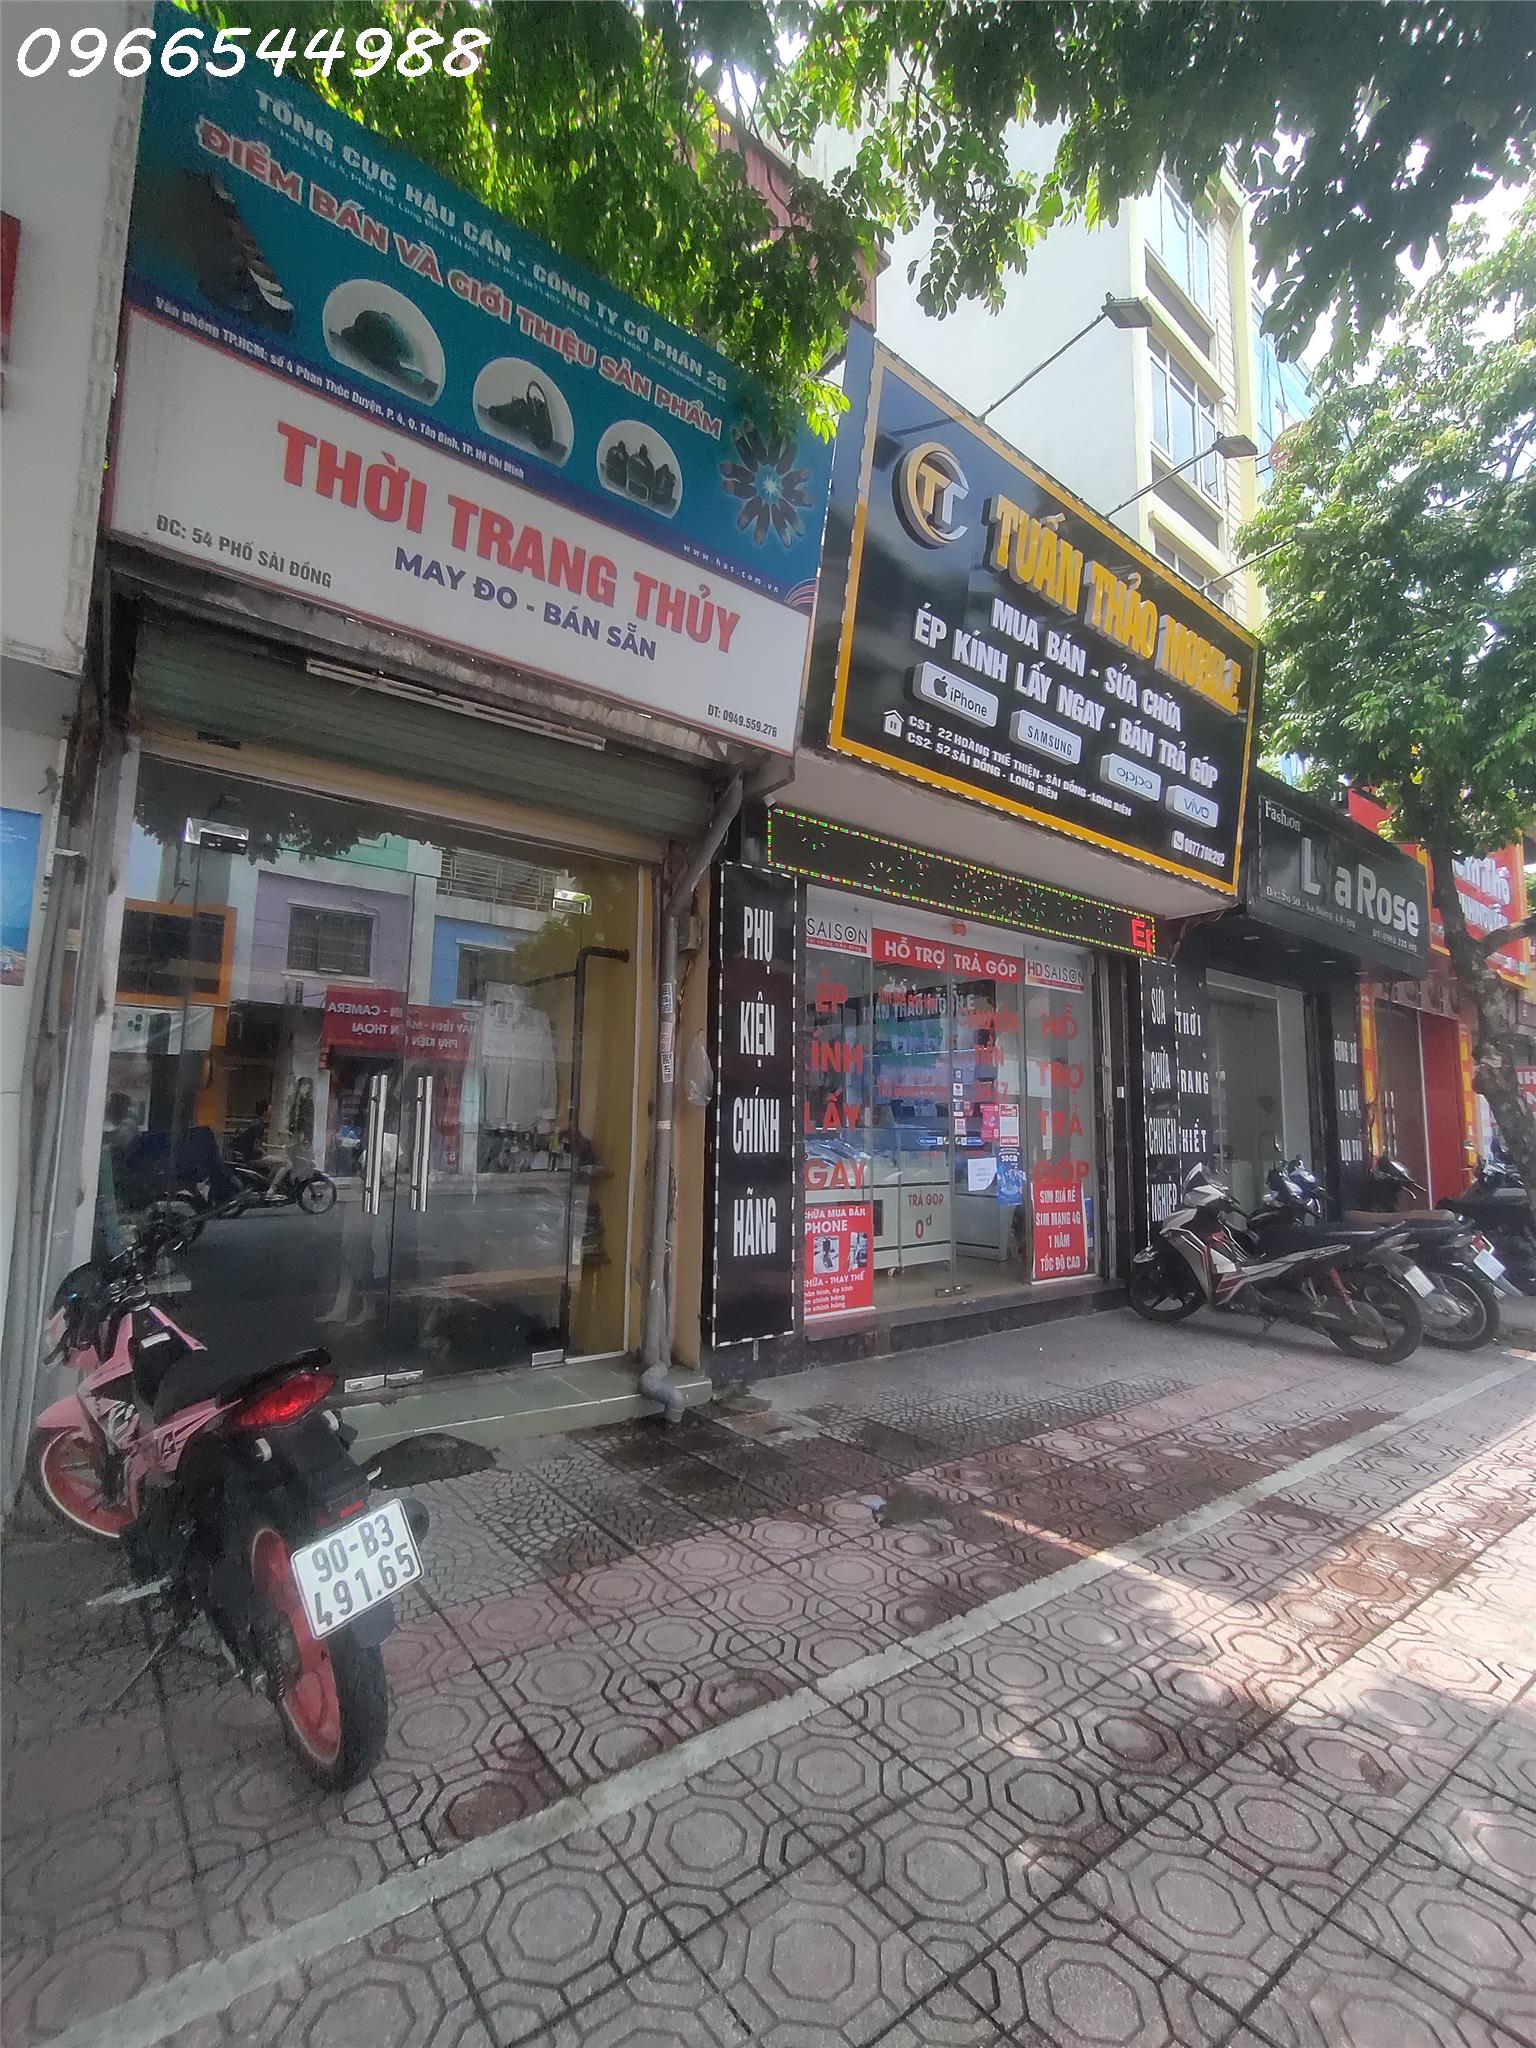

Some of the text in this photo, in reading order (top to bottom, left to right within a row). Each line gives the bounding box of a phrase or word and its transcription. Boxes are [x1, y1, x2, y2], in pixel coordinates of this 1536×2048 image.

[342, 145, 397, 190] CỤC
[533, 264, 590, 310] CÔNG
[596, 301, 618, 326] TY
[196, 113, 304, 206] ĐIỂM
[308, 180, 390, 255] BÁN
[392, 231, 444, 287] VÀ
[447, 268, 512, 325] GIỚI
[516, 303, 597, 366] THIỆU
[599, 354, 652, 401] SẢN
[654, 384, 722, 440] PHẨM
[157, 514, 332, 589] ĐC: 54 PHỐ SÀI ĐỒNG
[278, 420, 741, 653] THỜI TRANG THỦY
[395, 547, 466, 591] MAY
[473, 576, 518, 610] ĐO
[543, 601, 600, 640] BÁN
[607, 622, 656, 661] SẴN
[990, 494, 1242, 716] TUẤN THẢO MOBILE
[912, 602, 947, 649] ÉP
[952, 629, 1008, 683] KÍNH
[1014, 661, 1052, 704] LẤY
[1056, 684, 1105, 731] NGAY
[1119, 717, 1154, 757] BÁN
[1158, 738, 1187, 775] TRẢ
[1189, 756, 1218, 789] GÓP
[991, 598, 1039, 651] MUA
[1046, 630, 1086, 677] BÁN
[1103, 662, 1137, 708] SỬA
[1141, 688, 1181, 732] CHỮA
[722, 708, 778, 738] 0949.559.276
[950, 687, 987, 717] iPhone
[935, 742, 951, 757] 52
[951, 749, 971, 765] SÀI
[972, 757, 1001, 778] ĐỒNG
[1009, 772, 1035, 793] LONG
[1037, 783, 1058, 801] BIÊN
[937, 728, 952, 742] 22
[953, 734, 990, 758] HOÀNG
[1027, 725, 1072, 756] SAMSUNG
[1183, 796, 1209, 819] vivo
[1265, 800, 1301, 832] Fashion
[1357, 863, 1420, 938] Rose
[743, 904, 773, 975] PHỤ
[884, 936, 1017, 977] HỖ TRỢ TRẢ GÓP
[739, 991, 776, 1068] KIỆN
[805, 1025, 864, 1073] ÍNH
[732, 1086, 781, 1154] CHÍNH
[733, 1187, 778, 1258] HÃNG
[828, 1208, 846, 1218] MUA
[848, 1205, 866, 1217] BÁN
[1035, 1210, 1081, 1228] SIM MẠNG 4G
[1048, 1235, 1052, 1248] 1
[830, 1274, 848, 1285] THAY
[1040, 1253, 1054, 1272] TỐC
[311, 1514, 394, 1583] 90-B3
[314, 1542, 416, 1627] 491.65
